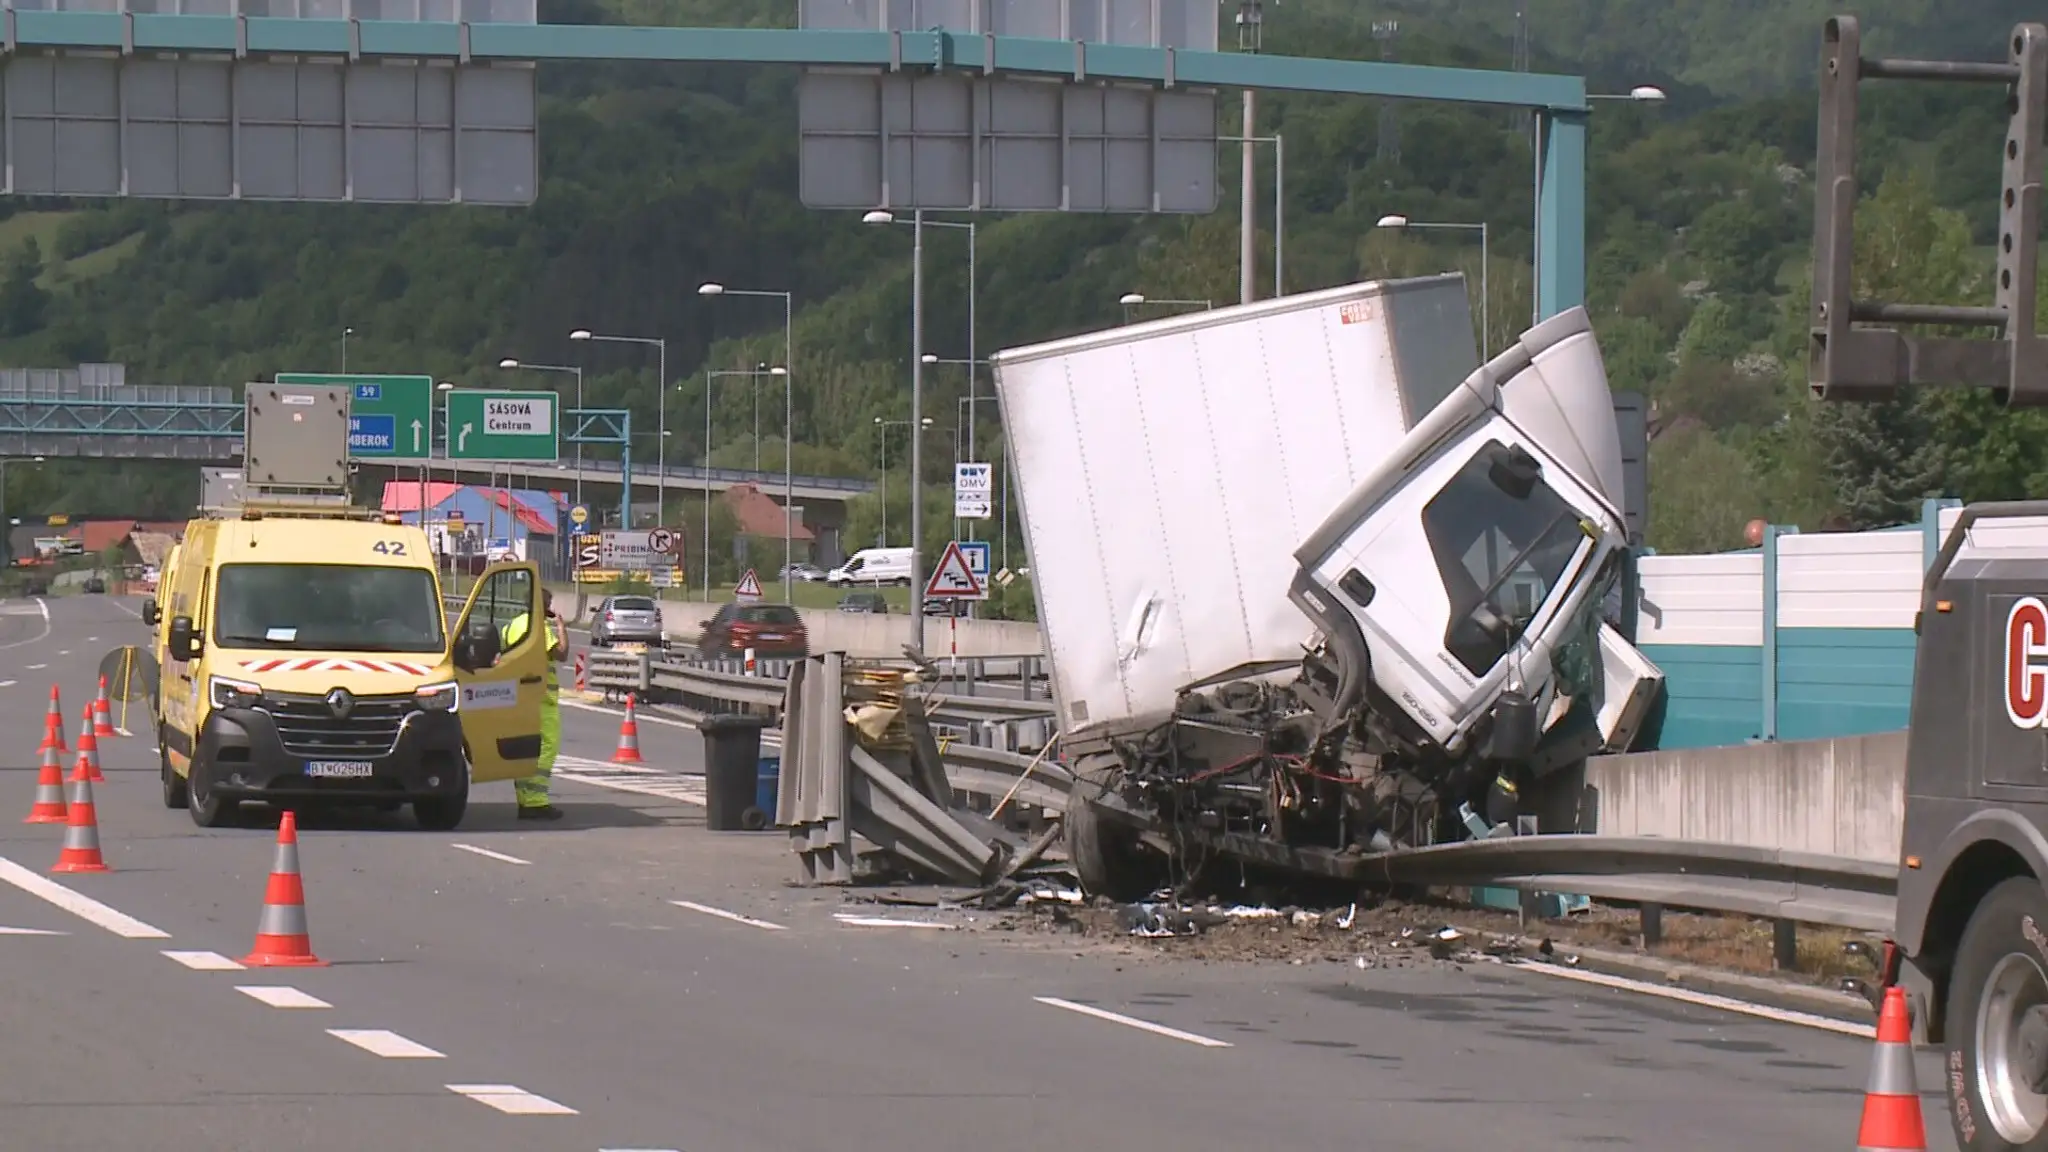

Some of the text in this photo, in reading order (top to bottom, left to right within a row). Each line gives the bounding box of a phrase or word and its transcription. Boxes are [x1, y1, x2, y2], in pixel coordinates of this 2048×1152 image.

[489, 401, 532, 415] SÁSOVÁ
[489, 418, 532, 430] Centrum
[348, 434, 390, 447] MBEROK
[960, 479, 987, 488] OMV
[372, 540, 408, 556] 42
[2005, 596, 2048, 730] C
